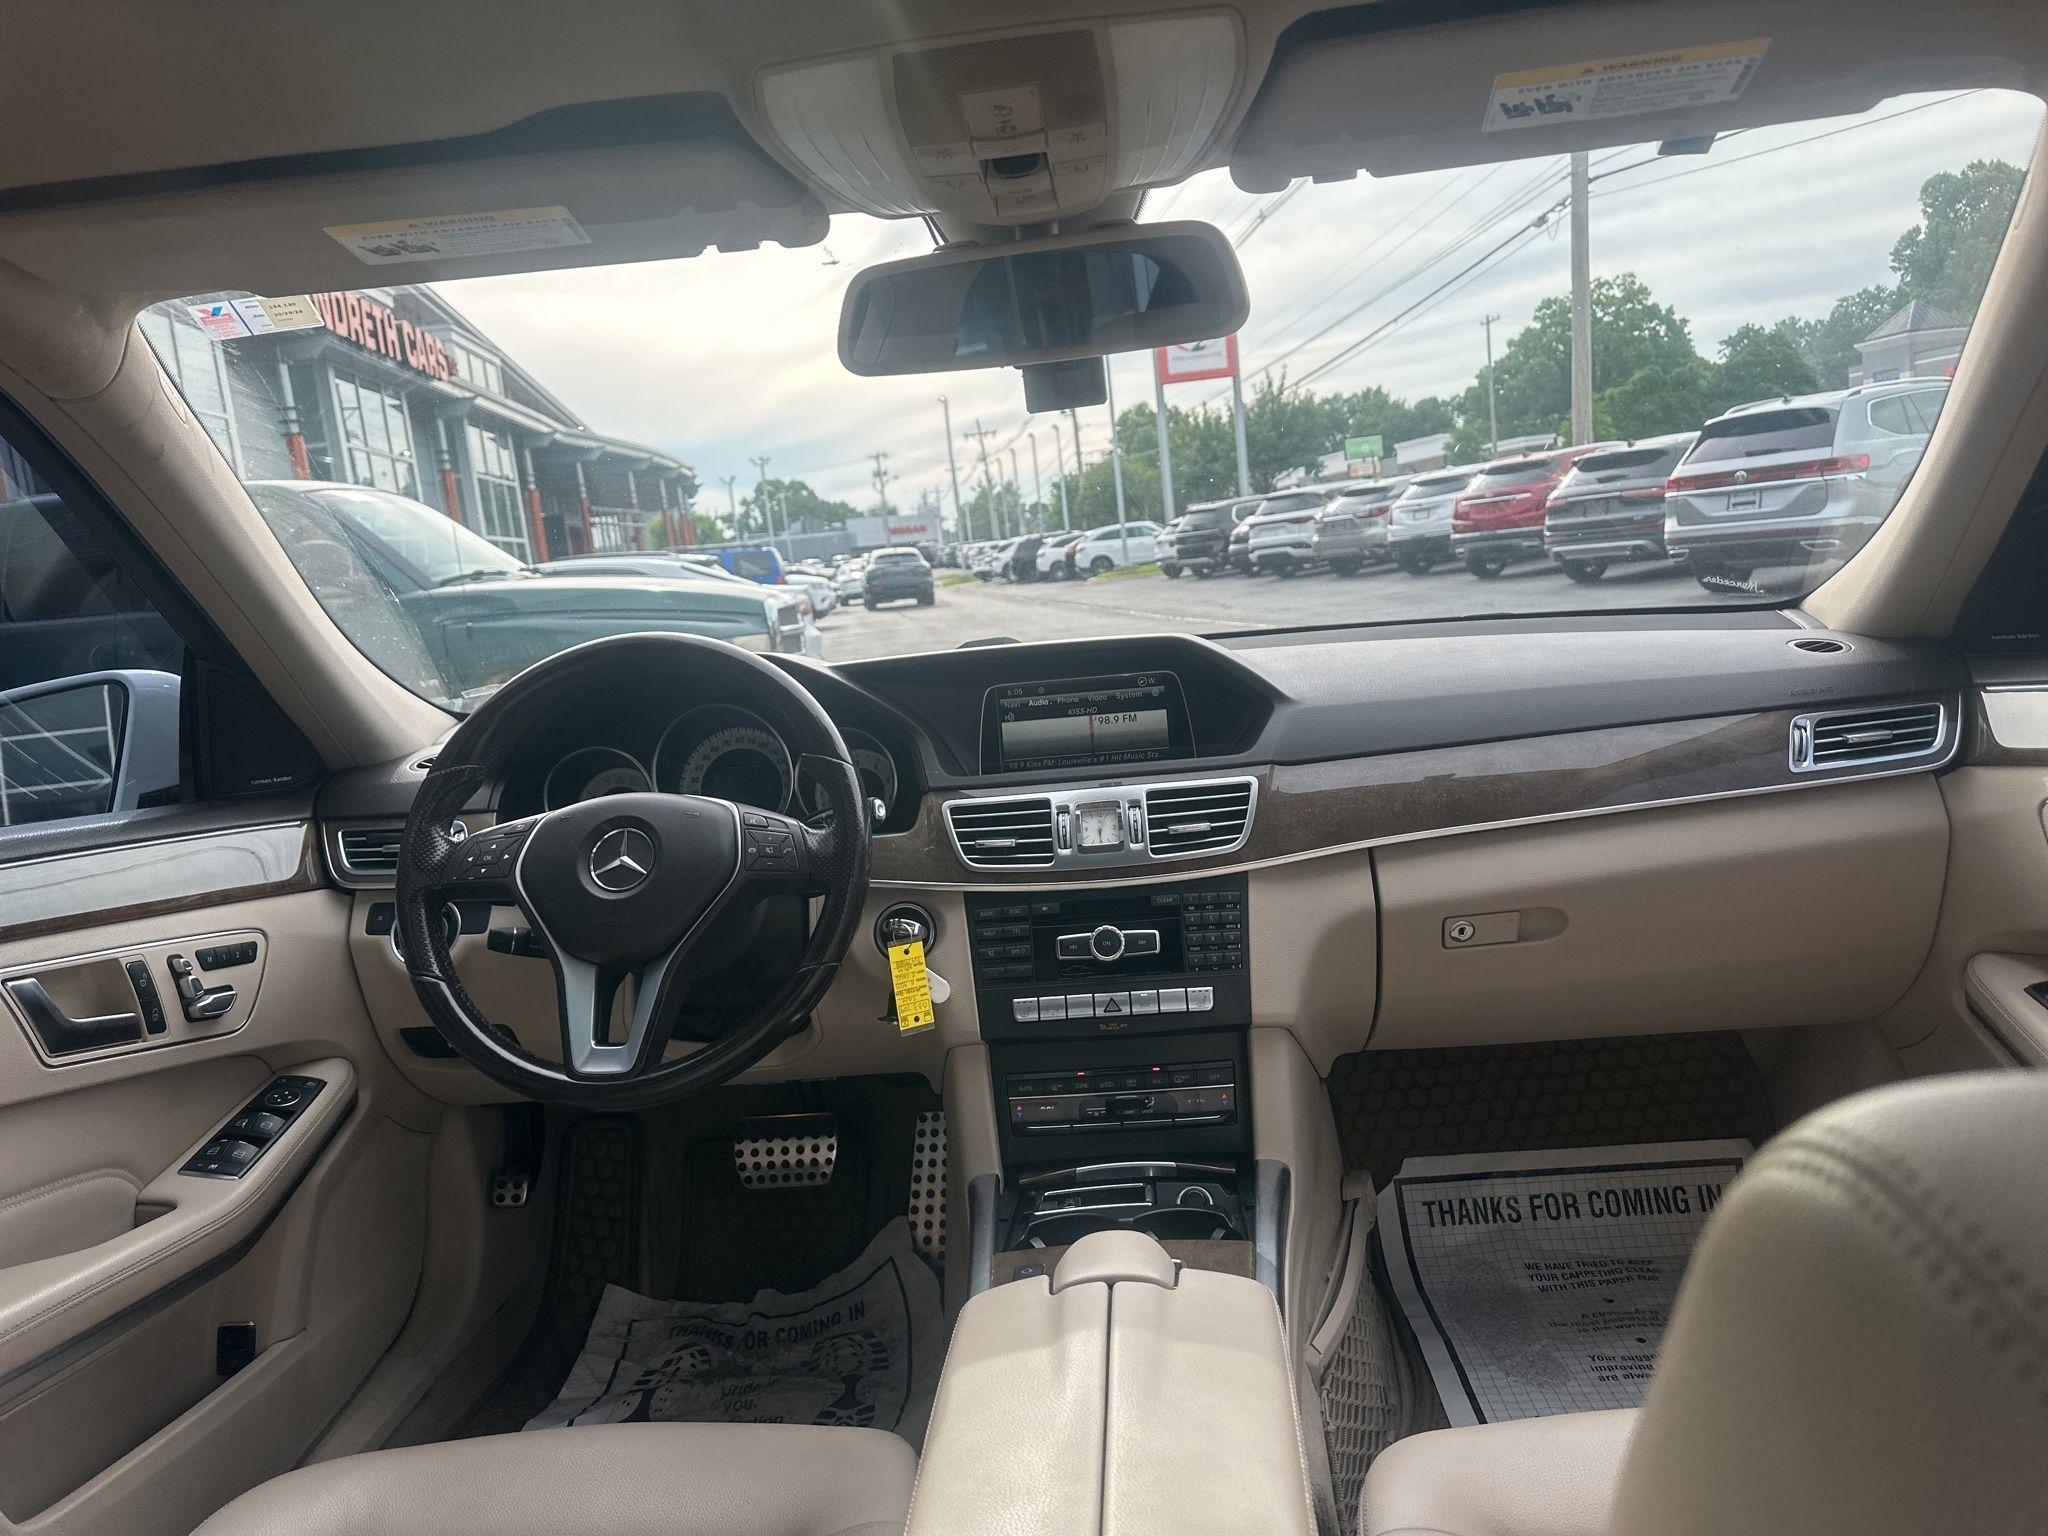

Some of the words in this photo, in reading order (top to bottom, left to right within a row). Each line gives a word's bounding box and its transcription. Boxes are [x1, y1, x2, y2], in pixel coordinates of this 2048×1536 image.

[1603, 55, 1682, 72] WARNING
[1558, 78, 1592, 88] WITH
[1600, 67, 1671, 82] ADVANCED
[1677, 62, 1700, 72] AIR
[397, 229, 428, 239] WITH
[432, 223, 497, 235] ADVANCED
[501, 219, 525, 228] AIR
[423, 215, 496, 227] WARNING
[402, 319, 449, 381] CARS
[1004, 701, 1021, 709] Navi
[1028, 699, 1049, 707] Audio
[1057, 696, 1080, 704] Phone
[1087, 694, 1108, 702] Video
[1115, 691, 1143, 701] System
[1007, 688, 1023, 696] 6:05
[1067, 706, 1098, 716] KISS-HD
[1098, 715, 1120, 726] 98.9
[1122, 713, 1138, 724] FM
[1008, 761, 1026, 769] 98.9
[1026, 760, 1042, 768] Kiss
[1057, 756, 1097, 766] Louisville's
[1110, 753, 1122, 762] Hit
[1123, 752, 1145, 761] Music
[1422, 1196, 1522, 1228] THANKS
[1529, 1191, 1581, 1222] FOR
[1587, 1185, 1690, 1219] COMING
[1697, 1184, 1723, 1213] IN
[1524, 1262, 1542, 1271] WE
[1544, 1260, 1573, 1271] HAVE
[1575, 1259, 1607, 1269] TRIED
[1528, 1272, 1559, 1282] YOUR
[1562, 1267, 1624, 1281] CARPETING
[1538, 1283, 1568, 1294] WITH
[1570, 1279, 1595, 1290] THIS
[1599, 1275, 1634, 1287] PAPER
[666, 1324, 734, 1349] THANKS
[774, 1310, 842, 1347] COMING
[849, 1300, 866, 1322] IN
[1588, 1354, 1616, 1362] Your
[1598, 1374, 1618, 1382] are
